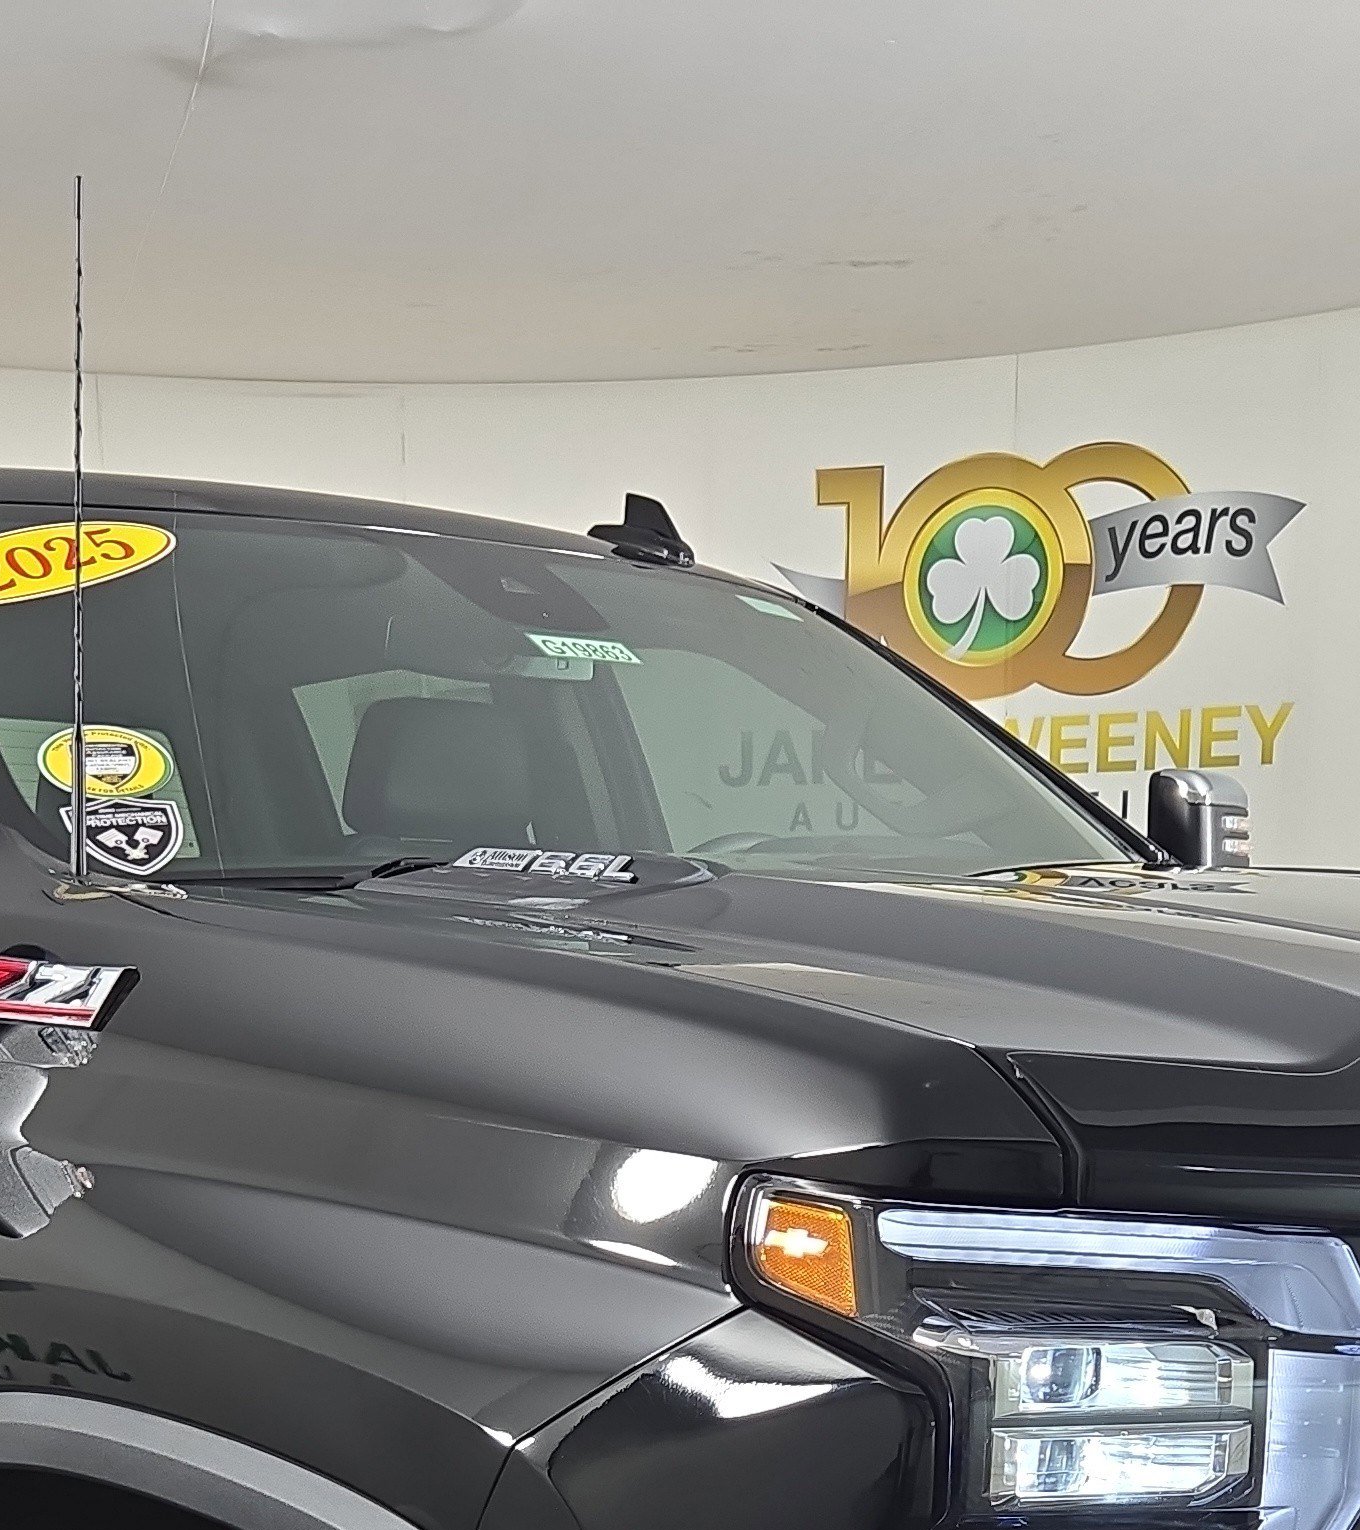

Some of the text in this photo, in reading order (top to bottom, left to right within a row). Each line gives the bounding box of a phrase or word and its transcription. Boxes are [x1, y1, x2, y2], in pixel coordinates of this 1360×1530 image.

[1104, 503, 1257, 582] years
[541, 638, 633, 662] G19863
[1004, 702, 1295, 775] EENEY
